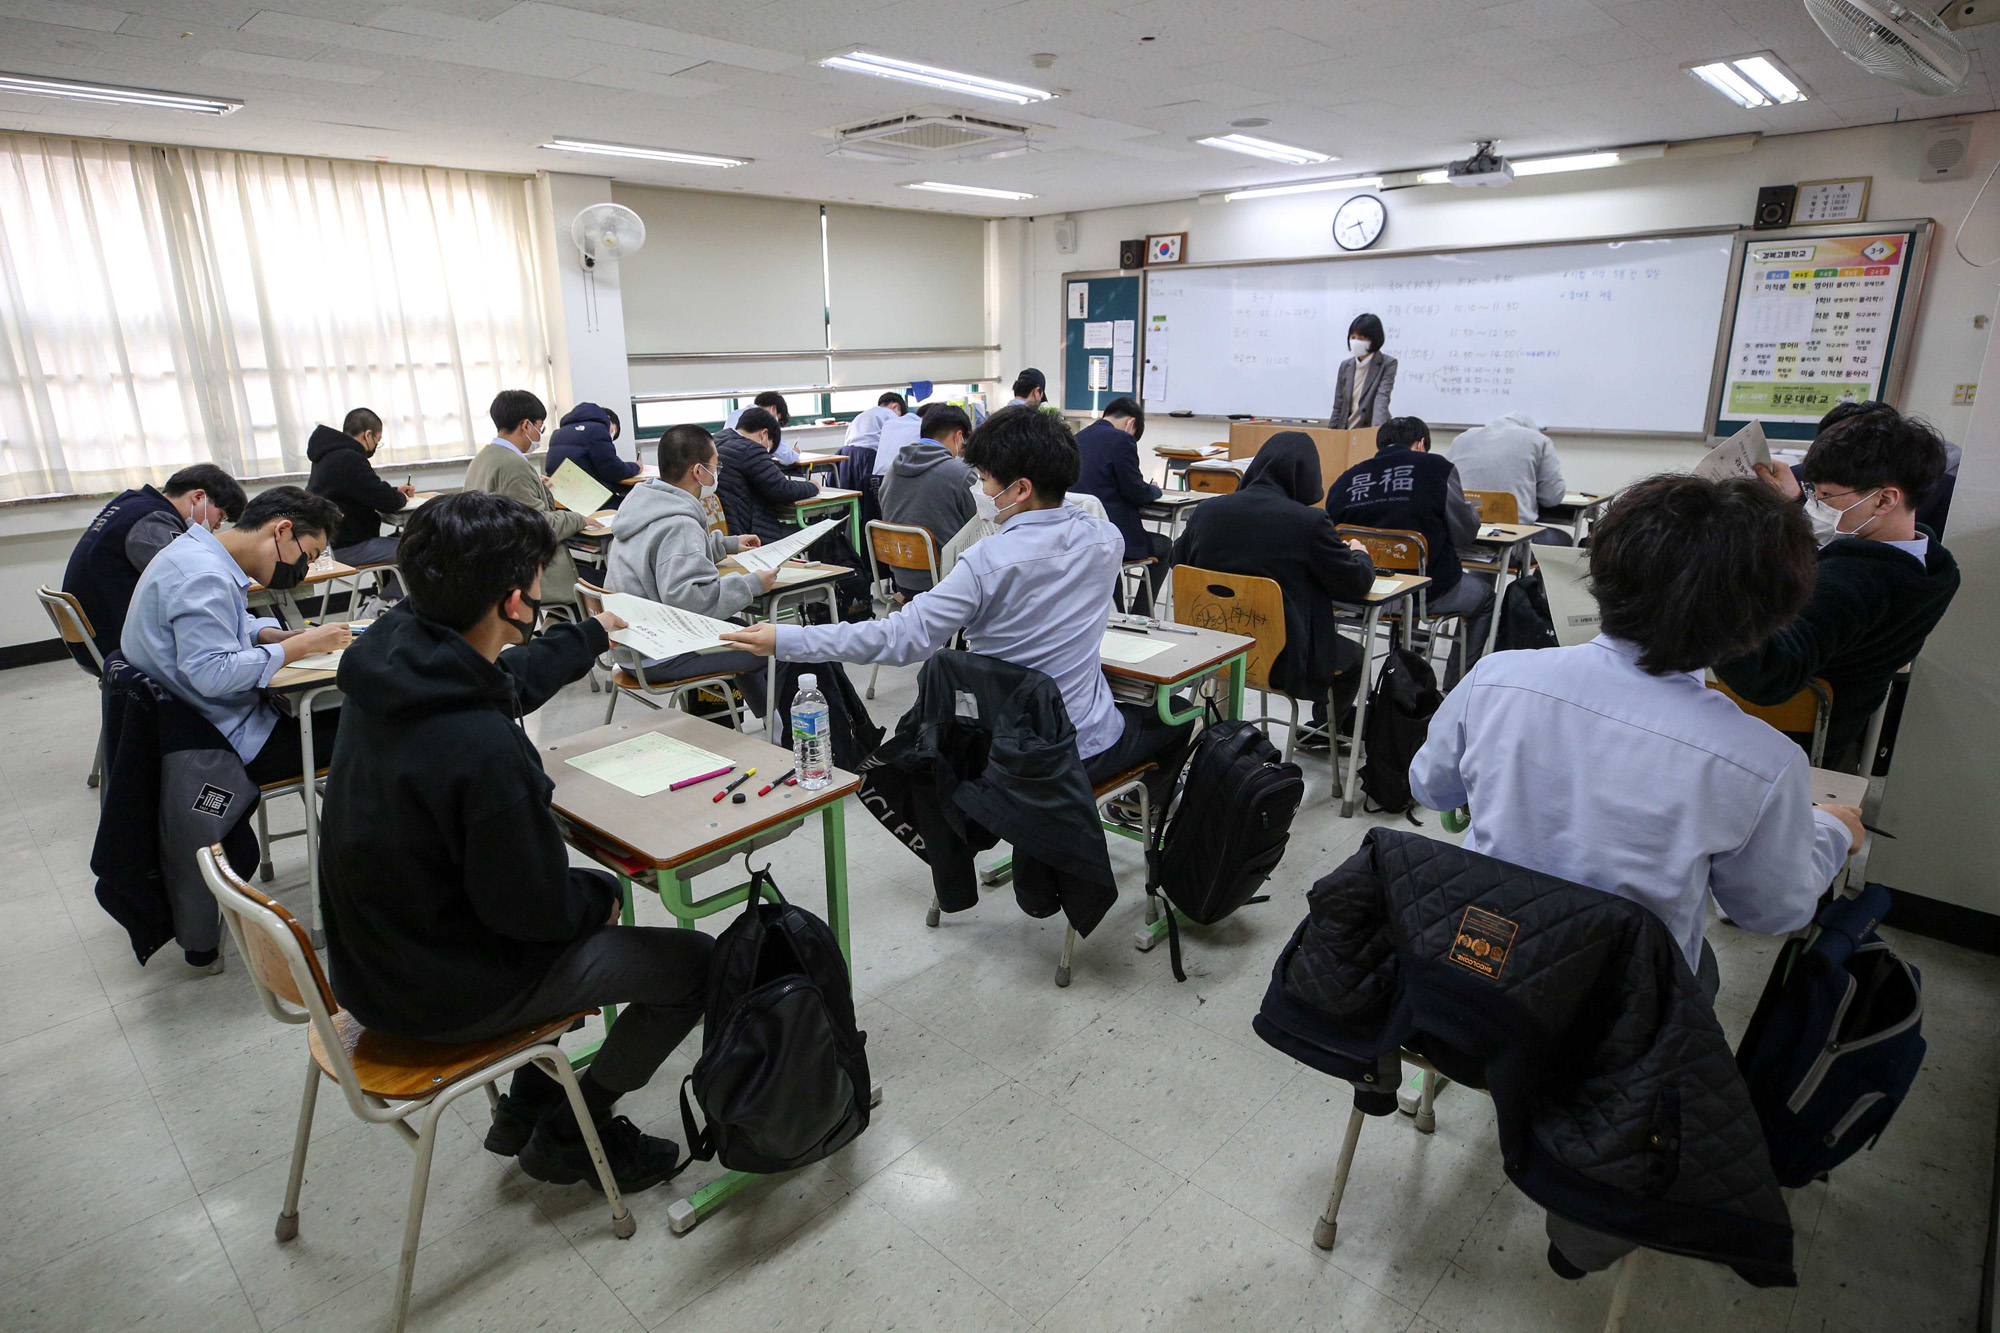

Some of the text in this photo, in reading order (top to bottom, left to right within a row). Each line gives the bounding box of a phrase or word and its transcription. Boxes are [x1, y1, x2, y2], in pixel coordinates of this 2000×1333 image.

[1762, 250, 1807, 260] 경복고등학교
[1870, 247, 1885, 255] 3-9
[1764, 282, 1787, 291] 미적분
[1820, 369, 1844, 377] 미적분
[1771, 393, 1829, 405] 청운대학교
[1346, 465, 1415, 502] 景福
